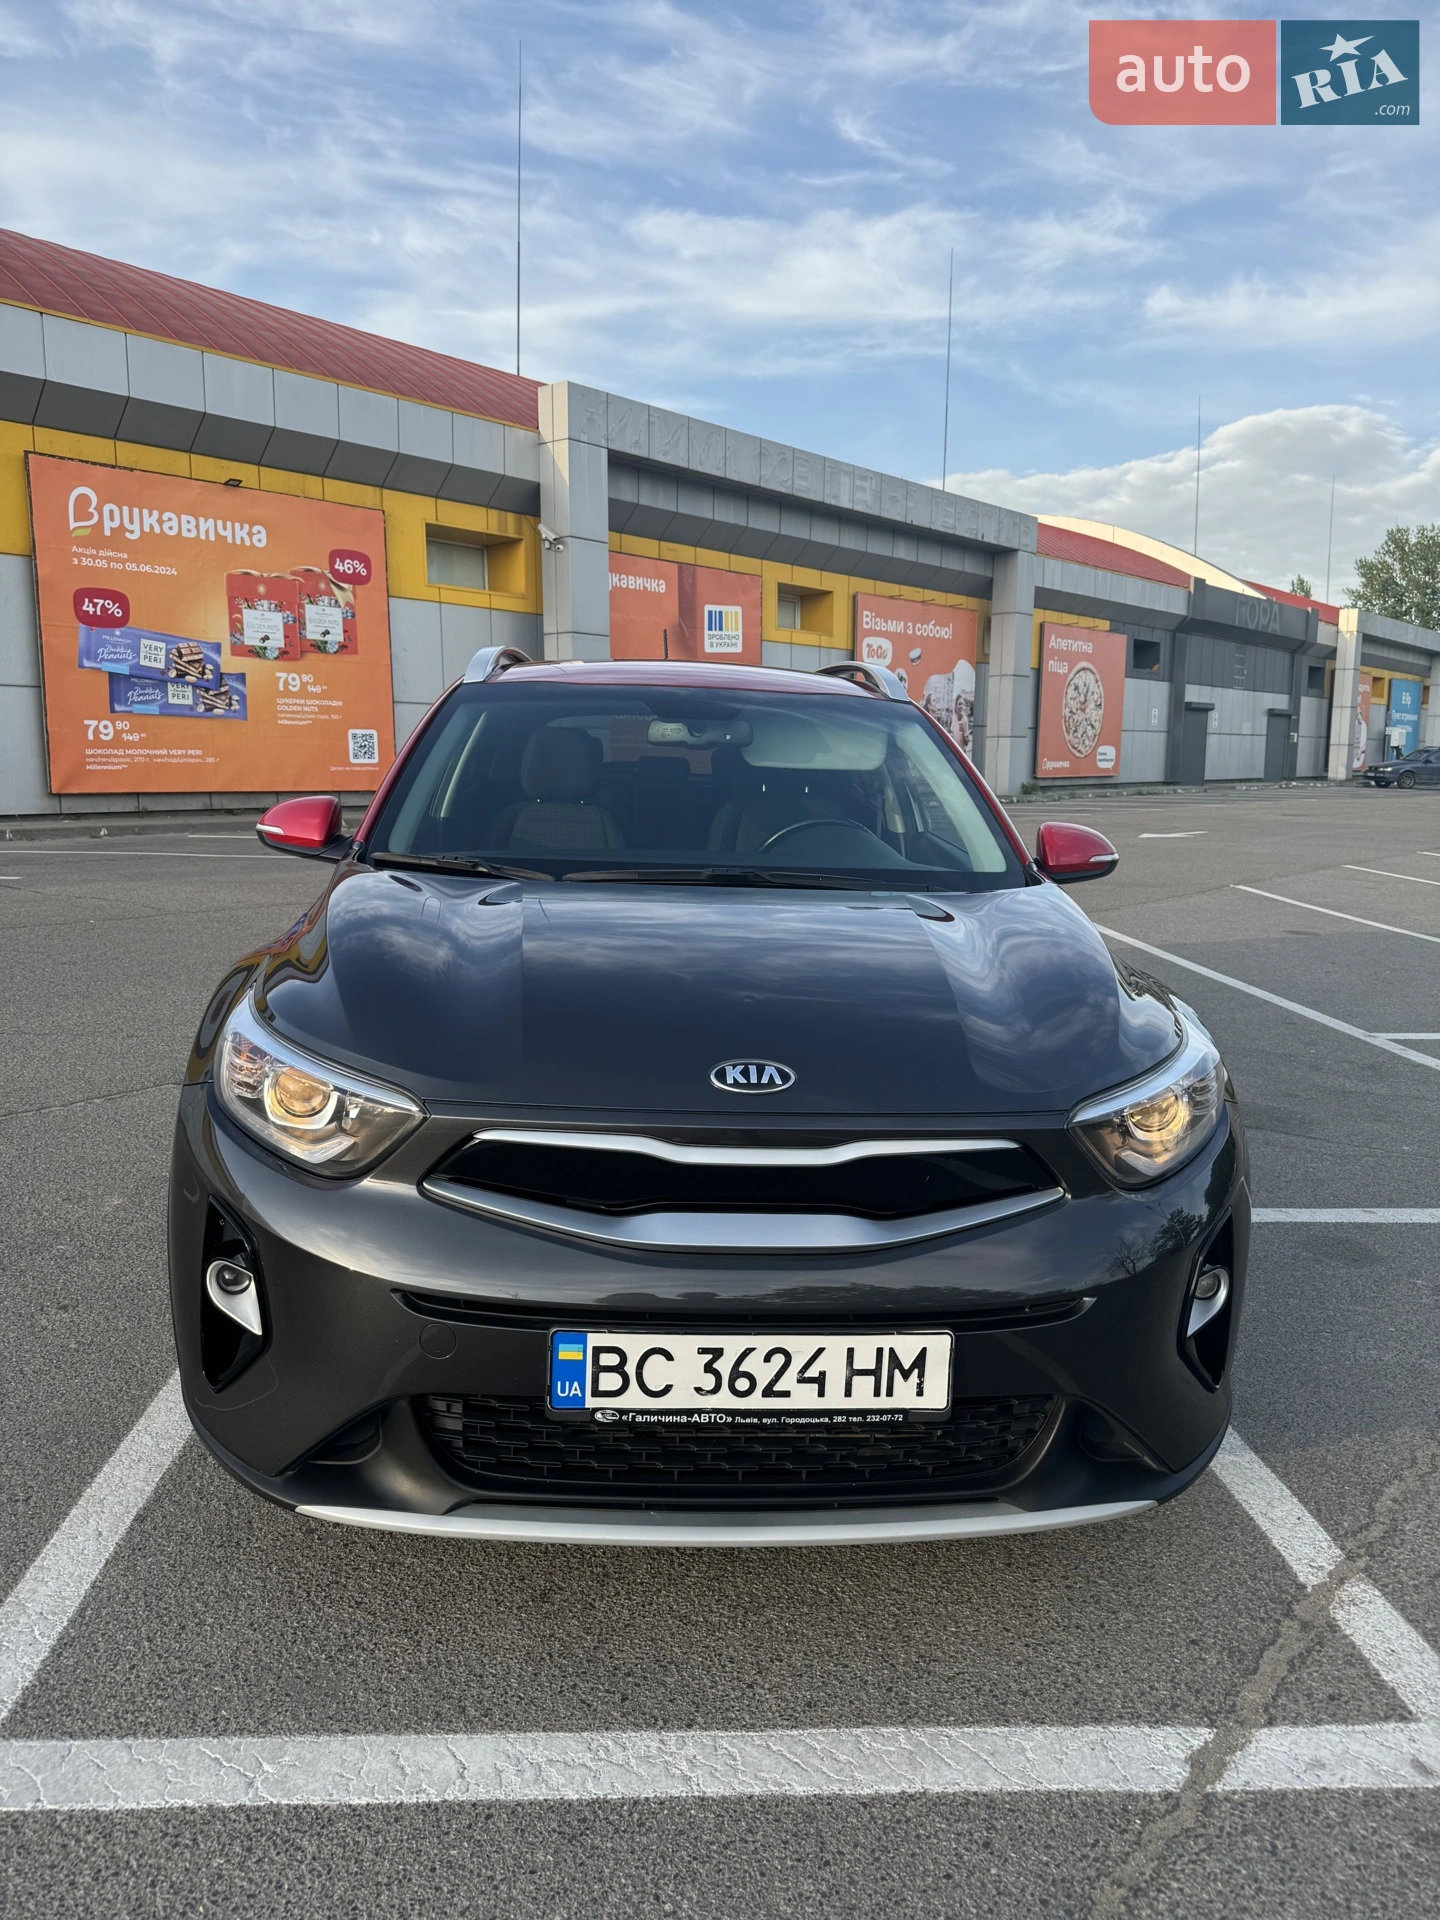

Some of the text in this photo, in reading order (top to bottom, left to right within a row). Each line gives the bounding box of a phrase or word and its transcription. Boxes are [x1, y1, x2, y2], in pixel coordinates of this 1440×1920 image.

[72, 545, 128, 559] Акція дійсна
[80, 557, 108, 568] 30.05
[110, 561, 123, 570] по
[126, 562, 178, 576] 05.06.2024
[334, 558, 367, 576] 46%
[82, 598, 123, 618] 47%
[1235, 595, 1280, 635] ГОРА
[862, 610, 953, 640] Візьми з собою!
[143, 643, 164, 653] VERY
[715, 640, 738, 648] УКРАЇНІ
[1049, 634, 1093, 654] Апетитна
[97, 648, 136, 662] Peanuts
[143, 654, 162, 664] PERI
[1048, 656, 1068, 675] піца
[276, 672, 314, 692] 79 90
[128, 690, 164, 705] Peanuts
[171, 693, 190, 701] PERI
[84, 720, 130, 741] 79 90
[85, 748, 124, 756] ШОКОЛАД
[125, 748, 168, 756] МОЛОЧНИЙ
[724, 1064, 783, 1085] KIA
[591, 1346, 928, 1398] BC 3624 HM
[557, 1381, 582, 1397] UA
[621, 1412, 732, 1424] «Галичина-АВТО»
[734, 1416, 760, 1424] Львів,
[781, 1416, 831, 1424] Городоцька,
[833, 1415, 847, 1423] 282
[866, 1414, 903, 1422] 232-07-72
